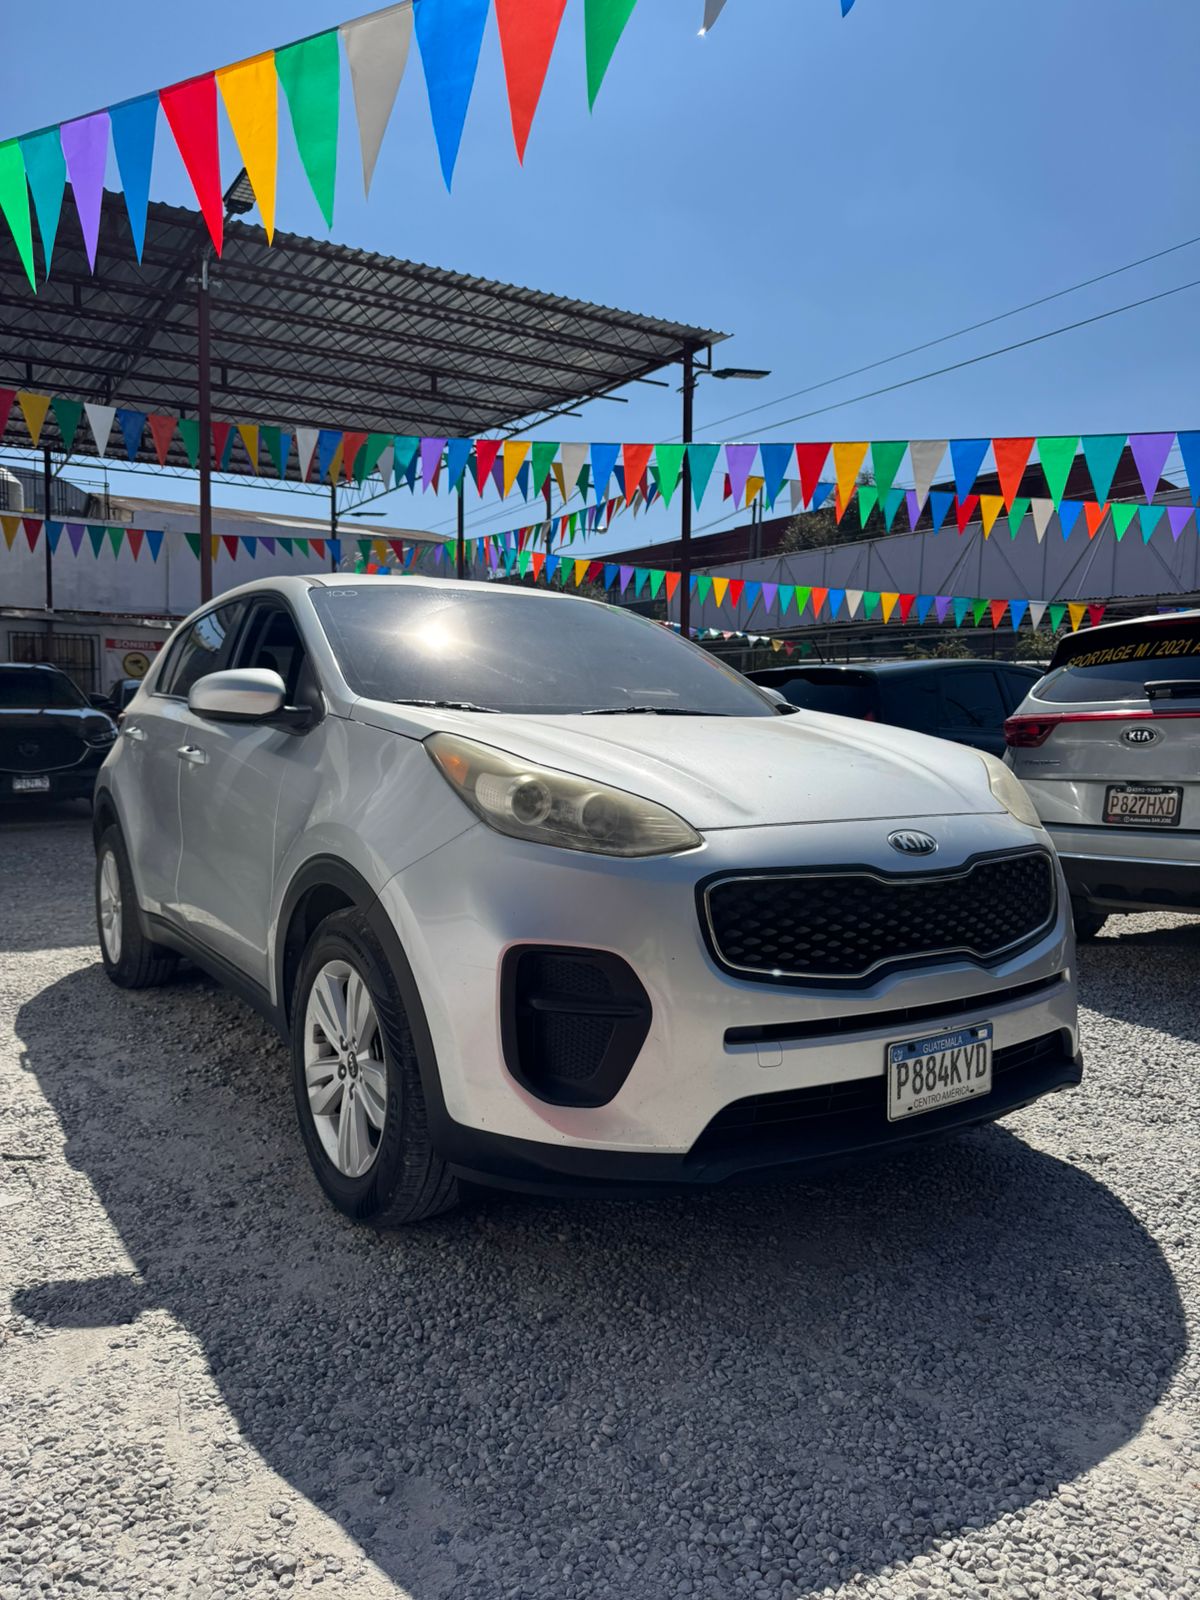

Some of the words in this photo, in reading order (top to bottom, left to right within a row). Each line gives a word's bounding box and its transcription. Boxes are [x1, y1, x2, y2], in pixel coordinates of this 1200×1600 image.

[1067, 643, 1137, 668] SPORTAGE
[1132, 641, 1152, 659] M
[1155, 638, 1194, 656] 2021
[1129, 731, 1151, 741] KIA
[1109, 795, 1177, 816] P827HXD
[895, 831, 934, 850] KIA
[922, 1035, 963, 1054] GUATEMALA
[896, 1042, 987, 1100] P884KYD
[913, 1092, 942, 1109] CENTRO
[942, 1084, 970, 1101] AMERICA
